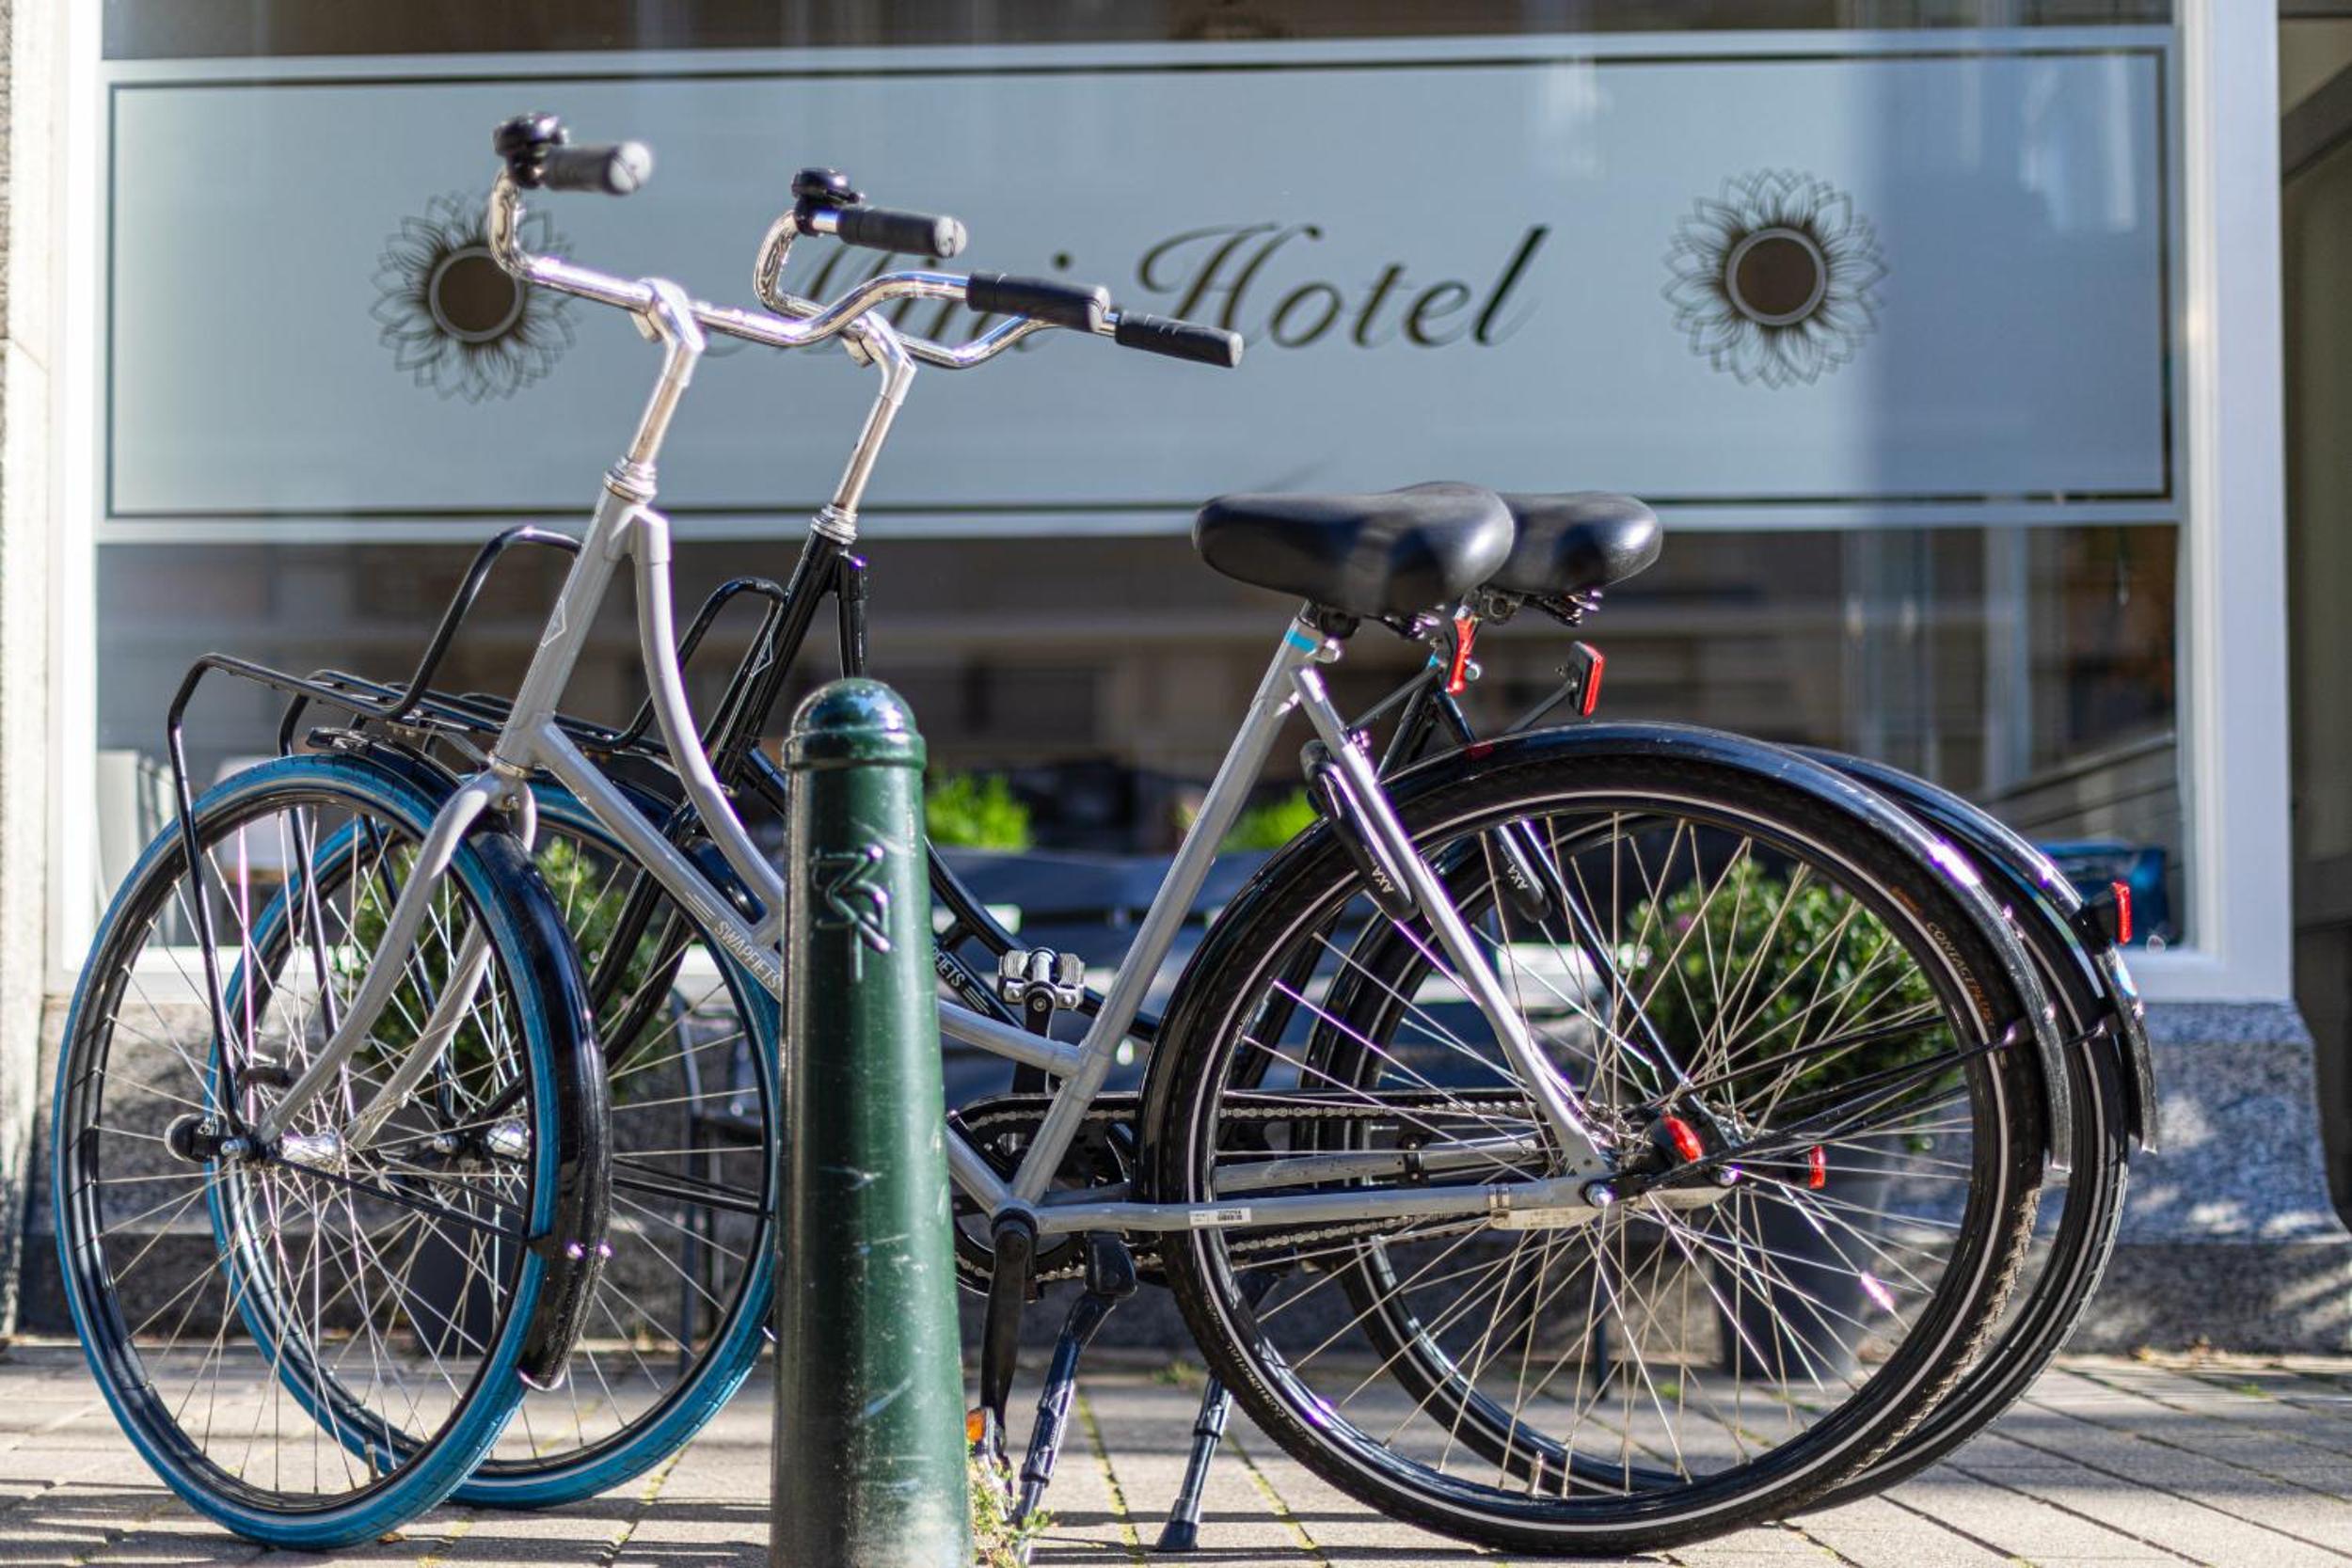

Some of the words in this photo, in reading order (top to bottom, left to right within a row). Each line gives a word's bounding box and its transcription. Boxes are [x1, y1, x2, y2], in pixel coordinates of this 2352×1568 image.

[1136, 222, 1546, 349] Hotel
[1372, 864, 1395, 893] AXA
[1507, 863, 1529, 890] AXA
[714, 920, 781, 990] SWAPFIETS
